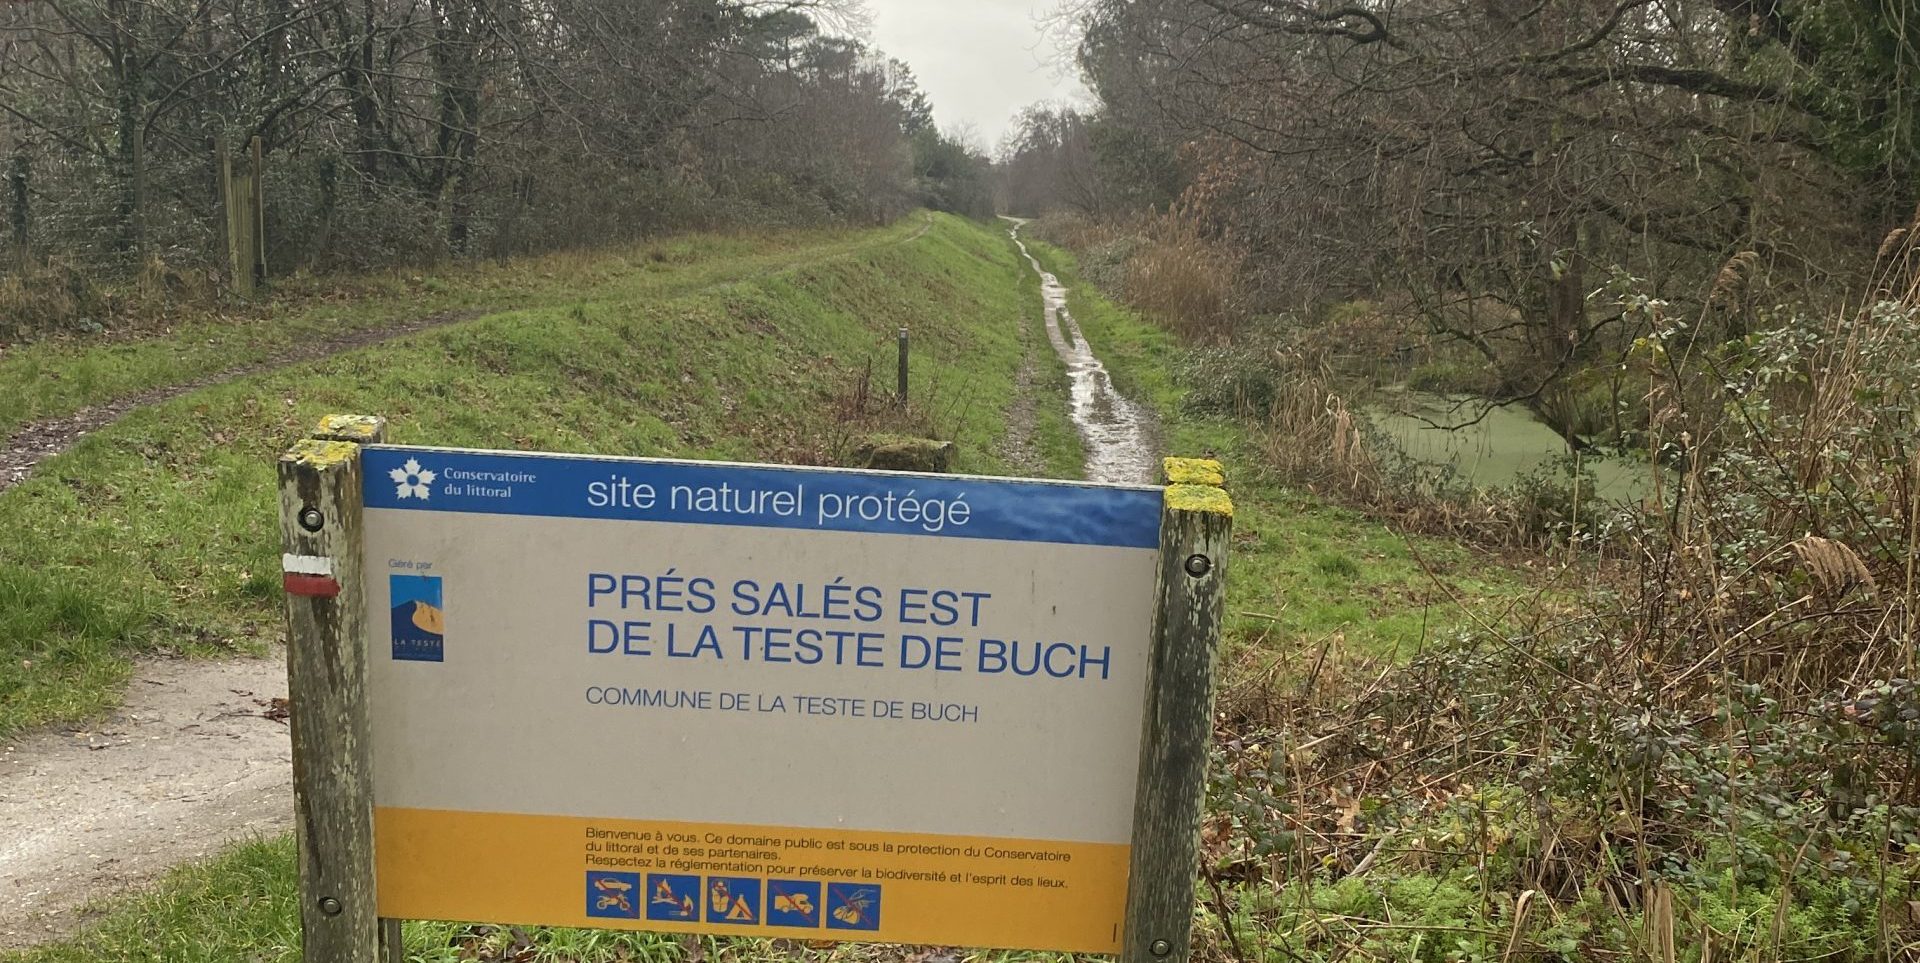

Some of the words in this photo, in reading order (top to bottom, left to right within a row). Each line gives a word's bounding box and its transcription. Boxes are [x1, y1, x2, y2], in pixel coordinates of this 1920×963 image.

[443, 466, 537, 484] Conservatoire
[444, 483, 462, 496] du
[467, 485, 512, 498] littoral
[587, 474, 656, 509] site
[671, 483, 803, 517] naturel
[819, 490, 971, 532] protégé
[416, 562, 432, 571] par
[587, 568, 716, 614] PRÉS
[731, 576, 883, 623] SALÉS
[900, 588, 992, 628] EST
[587, 620, 651, 657] DE
[667, 623, 724, 660] LA
[733, 626, 884, 668] TESTE
[900, 635, 964, 673] DE
[978, 639, 1112, 681] BUCH
[586, 686, 712, 710] COMMUNE
[719, 692, 750, 712] DE
[758, 694, 786, 713] LA
[793, 696, 866, 717] TESTE
[873, 700, 904, 719] DE
[911, 703, 979, 723] BUCH
[585, 827, 652, 842] Bienvenue
[655, 830, 663, 842] à
[667, 832, 700, 843] vous.
[704, 832, 723, 845] Ce
[726, 833, 781, 847] domaine
[784, 836, 823, 851] public
[826, 839, 845, 851] est
[849, 841, 880, 853] sous
[883, 841, 894, 853] la
[897, 842, 961, 857] protection
[964, 844, 981, 858] du
[984, 846, 1071, 863] Conservatoire
[585, 840, 602, 852] du
[606, 841, 643, 855] littoral
[646, 844, 658, 855] et
[663, 843, 679, 856] de
[683, 847, 705, 857] ses
[708, 846, 781, 862] partenaires.
[585, 853, 652, 869] Respectez
[655, 856, 666, 869] la
[670, 857, 762, 874] réglementation
[766, 864, 795, 876] pour
[799, 863, 858, 879] préserver
[861, 866, 872, 879] la
[876, 868, 947, 883] biodiversité
[949, 872, 962, 883] et
[965, 872, 1006, 886] l'esprit
[1010, 874, 1034, 887] des
[1037, 876, 1069, 889] lieux.
